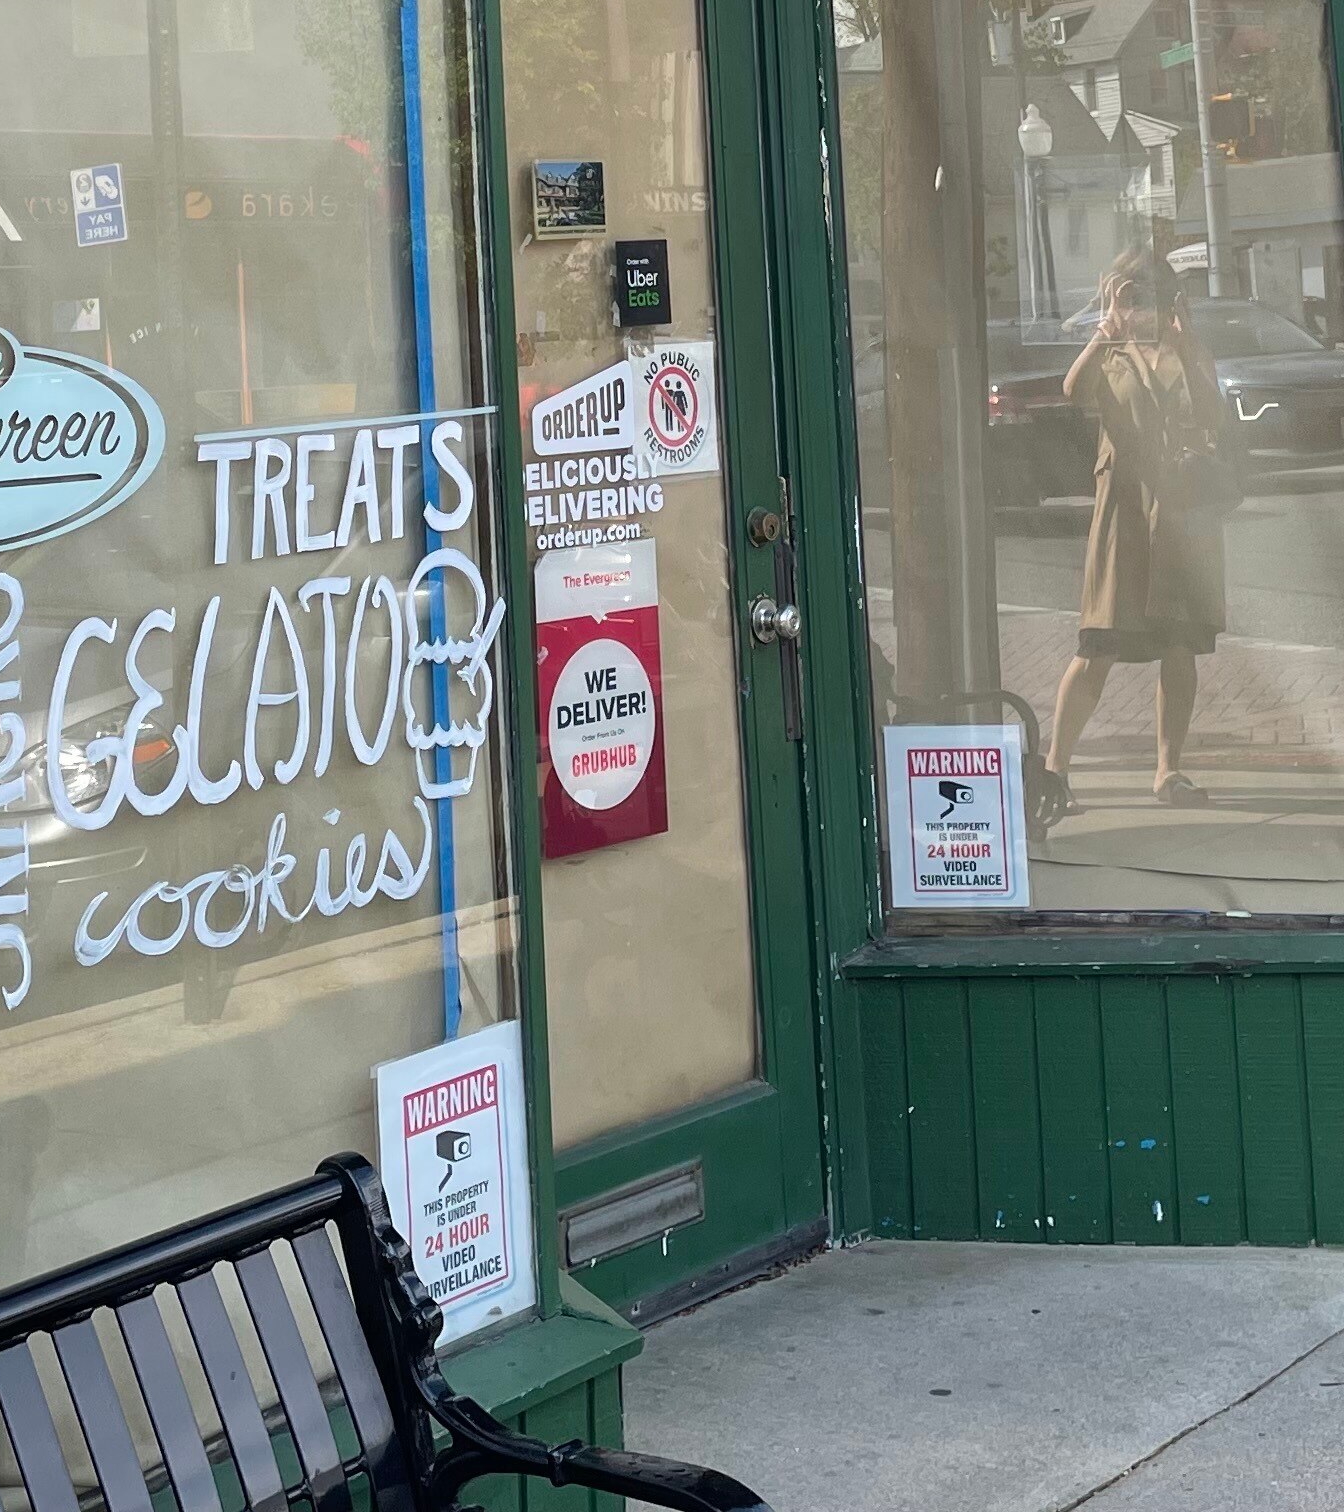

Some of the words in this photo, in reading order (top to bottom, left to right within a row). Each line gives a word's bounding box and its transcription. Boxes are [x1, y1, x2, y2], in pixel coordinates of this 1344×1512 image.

[626, 269, 659, 287] Uber
[628, 290, 660, 307] Eats
[644, 361, 659, 385] NO
[660, 351, 700, 383] PUBLIC
[643, 426, 705, 464] RESTROOMS
[523, 452, 660, 492] ELICIOUSLY
[197, 420, 476, 565] TREATS
[524, 483, 664, 527] ELIVERING
[536, 522, 641, 551] orderup.com
[562, 575, 582, 588] The
[583, 666, 617, 694] WE
[47, 574, 402, 830] GELATO
[557, 690, 647, 730] DELIVER!
[571, 743, 637, 778] GRUBHUB
[910, 750, 999, 775] WARNING
[925, 822, 945, 831] THIS
[947, 822, 991, 831] PROPERTY
[939, 833, 947, 842] IS
[950, 833, 978, 842] UNDER
[927, 844, 945, 858] 24
[951, 844, 991, 858] HOUR
[943, 860, 977, 872] VIDEO
[74, 796, 431, 967] cookies
[919, 874, 1002, 886] SURVEILLANCE
[406, 1068, 496, 1134] WARNING
[423, 1198, 443, 1217] THIS
[444, 1179, 489, 1210] PROPERTY
[437, 1213, 446, 1228] IS
[447, 1202, 477, 1224] UNDER
[424, 1230, 444, 1259] 24
[449, 1212, 490, 1248] HOUR
[441, 1243, 476, 1273] VIDEO
[424, 1254, 502, 1301] URVEILLANCE
